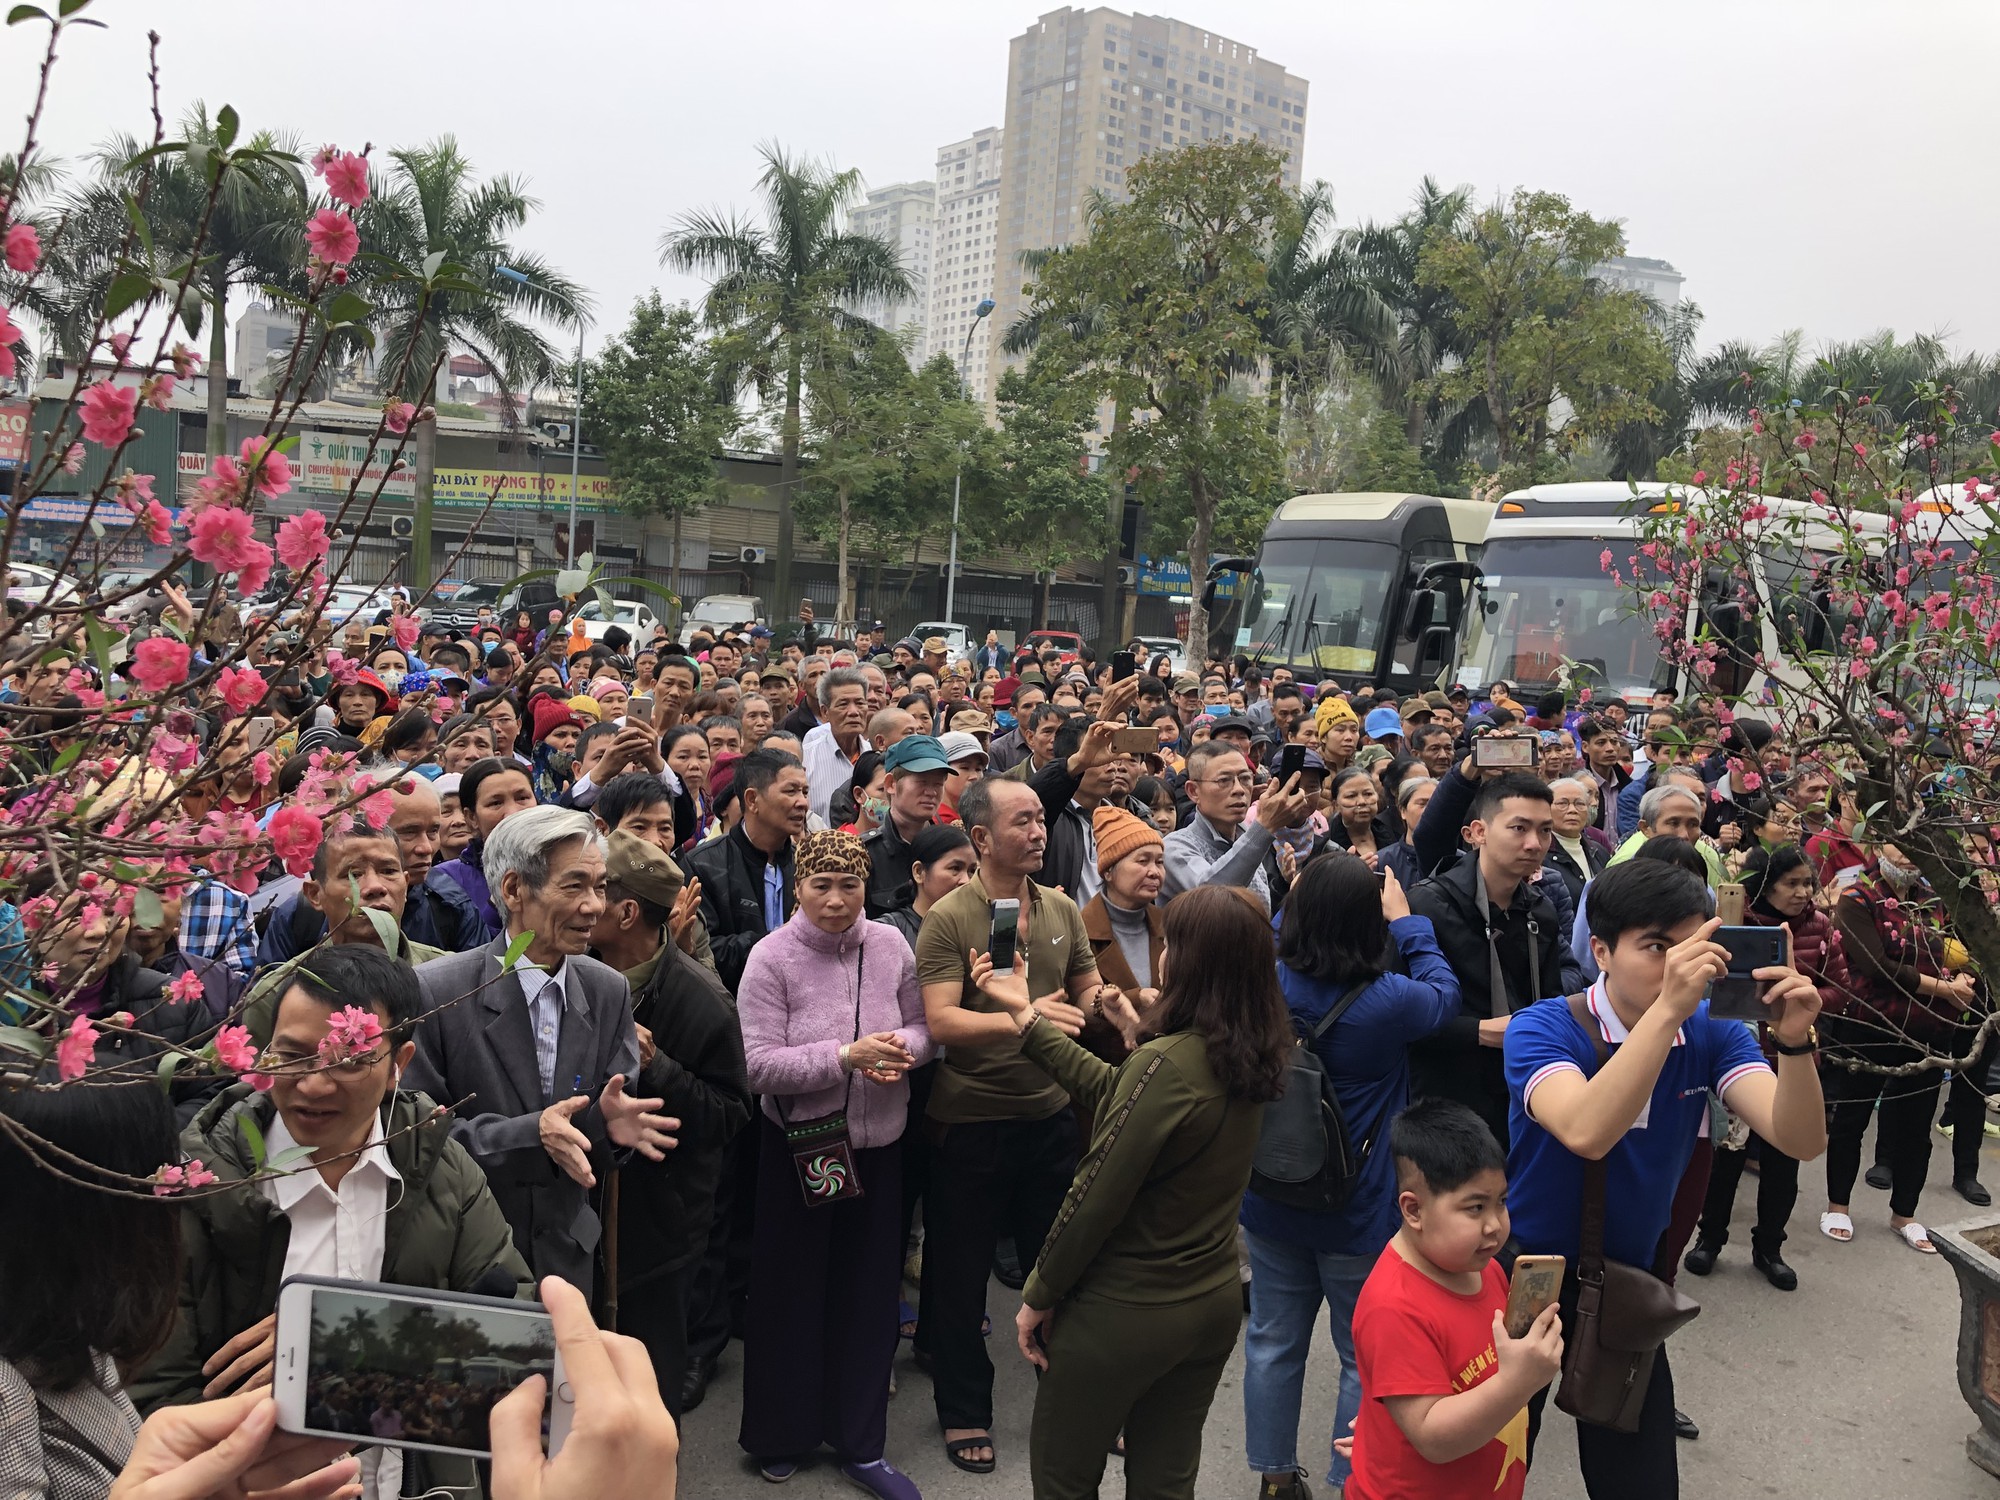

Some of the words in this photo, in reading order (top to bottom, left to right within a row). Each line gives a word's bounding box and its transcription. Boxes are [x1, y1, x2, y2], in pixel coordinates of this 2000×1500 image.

[352, 446, 378, 464] THUC
[433, 474, 452, 487] TẠI
[454, 473, 478, 486] ĐÂY
[1146, 560, 1165, 576] TP
[1459, 1354, 1487, 1385] NIỆM
